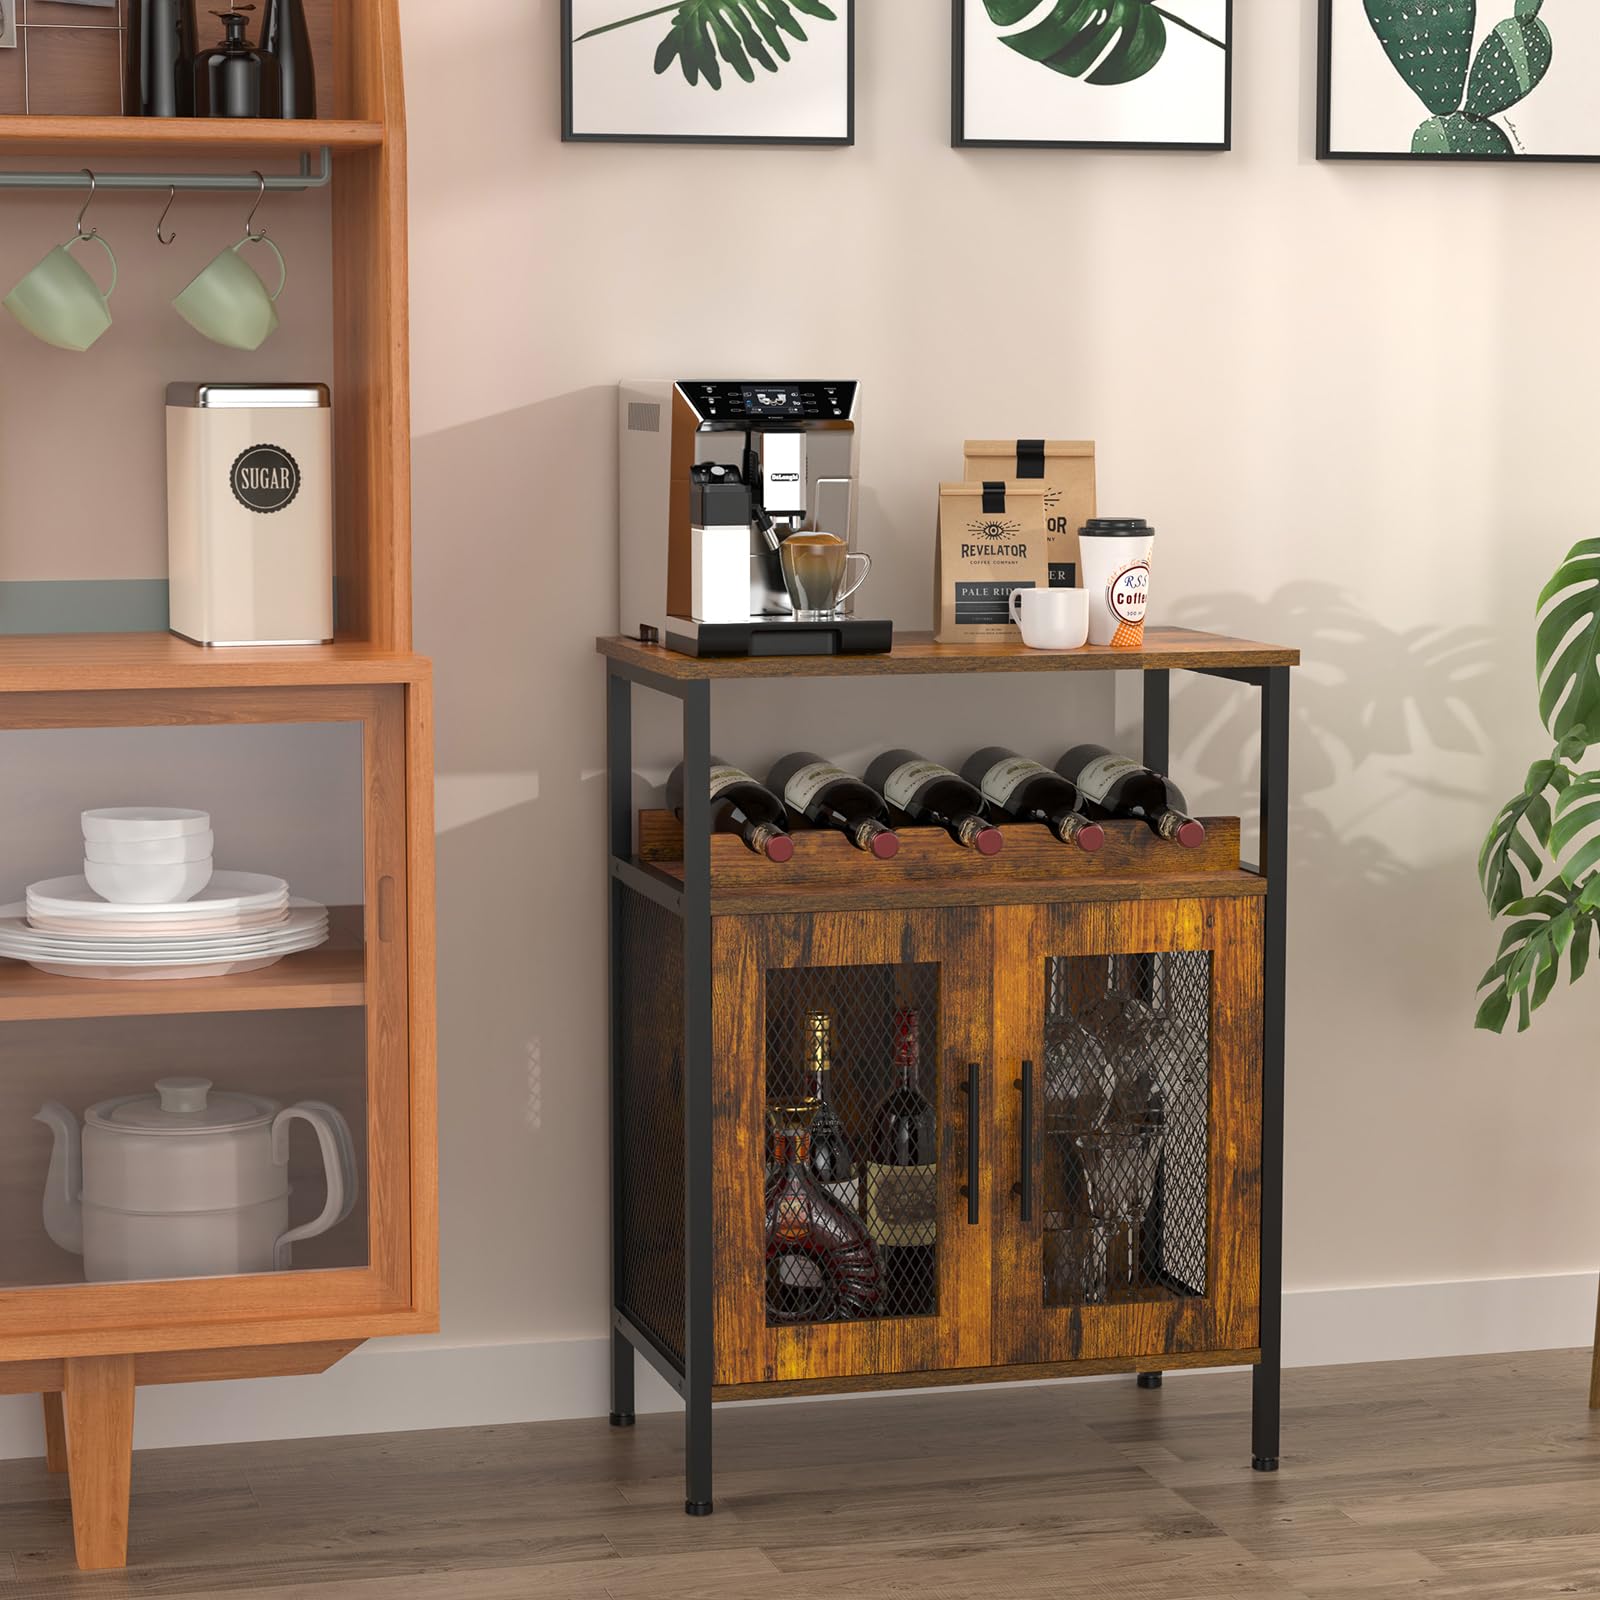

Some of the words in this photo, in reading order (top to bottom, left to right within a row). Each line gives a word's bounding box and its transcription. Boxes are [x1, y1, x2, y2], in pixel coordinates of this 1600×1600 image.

[241, 467, 290, 489] SUGAR
[961, 544, 1027, 558] REVELATOR
[962, 587, 989, 596] PALE
[993, 587, 1013, 596] RID
